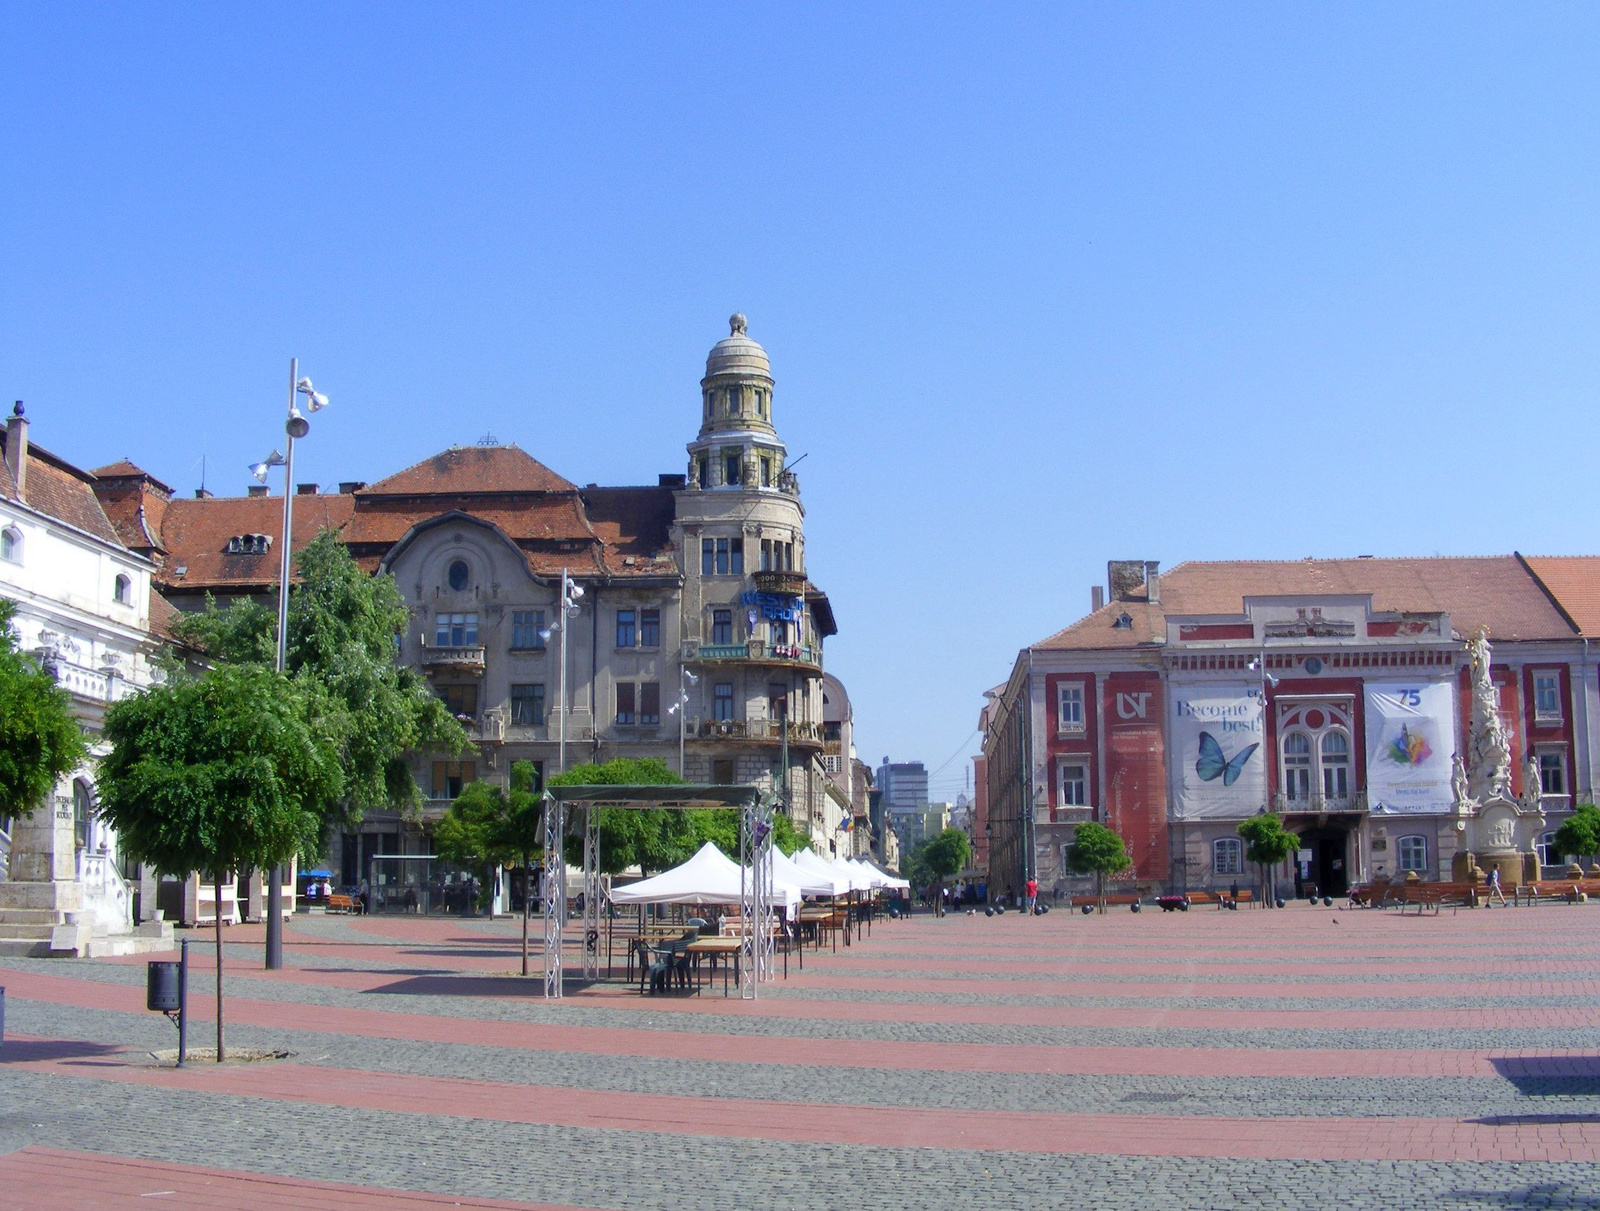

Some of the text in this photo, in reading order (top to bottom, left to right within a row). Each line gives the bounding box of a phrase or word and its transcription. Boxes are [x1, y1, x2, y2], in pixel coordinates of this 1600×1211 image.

[1396, 689, 1421, 707] 75
[1177, 701, 1247, 717] Become
[1222, 716, 1260, 733] best!
